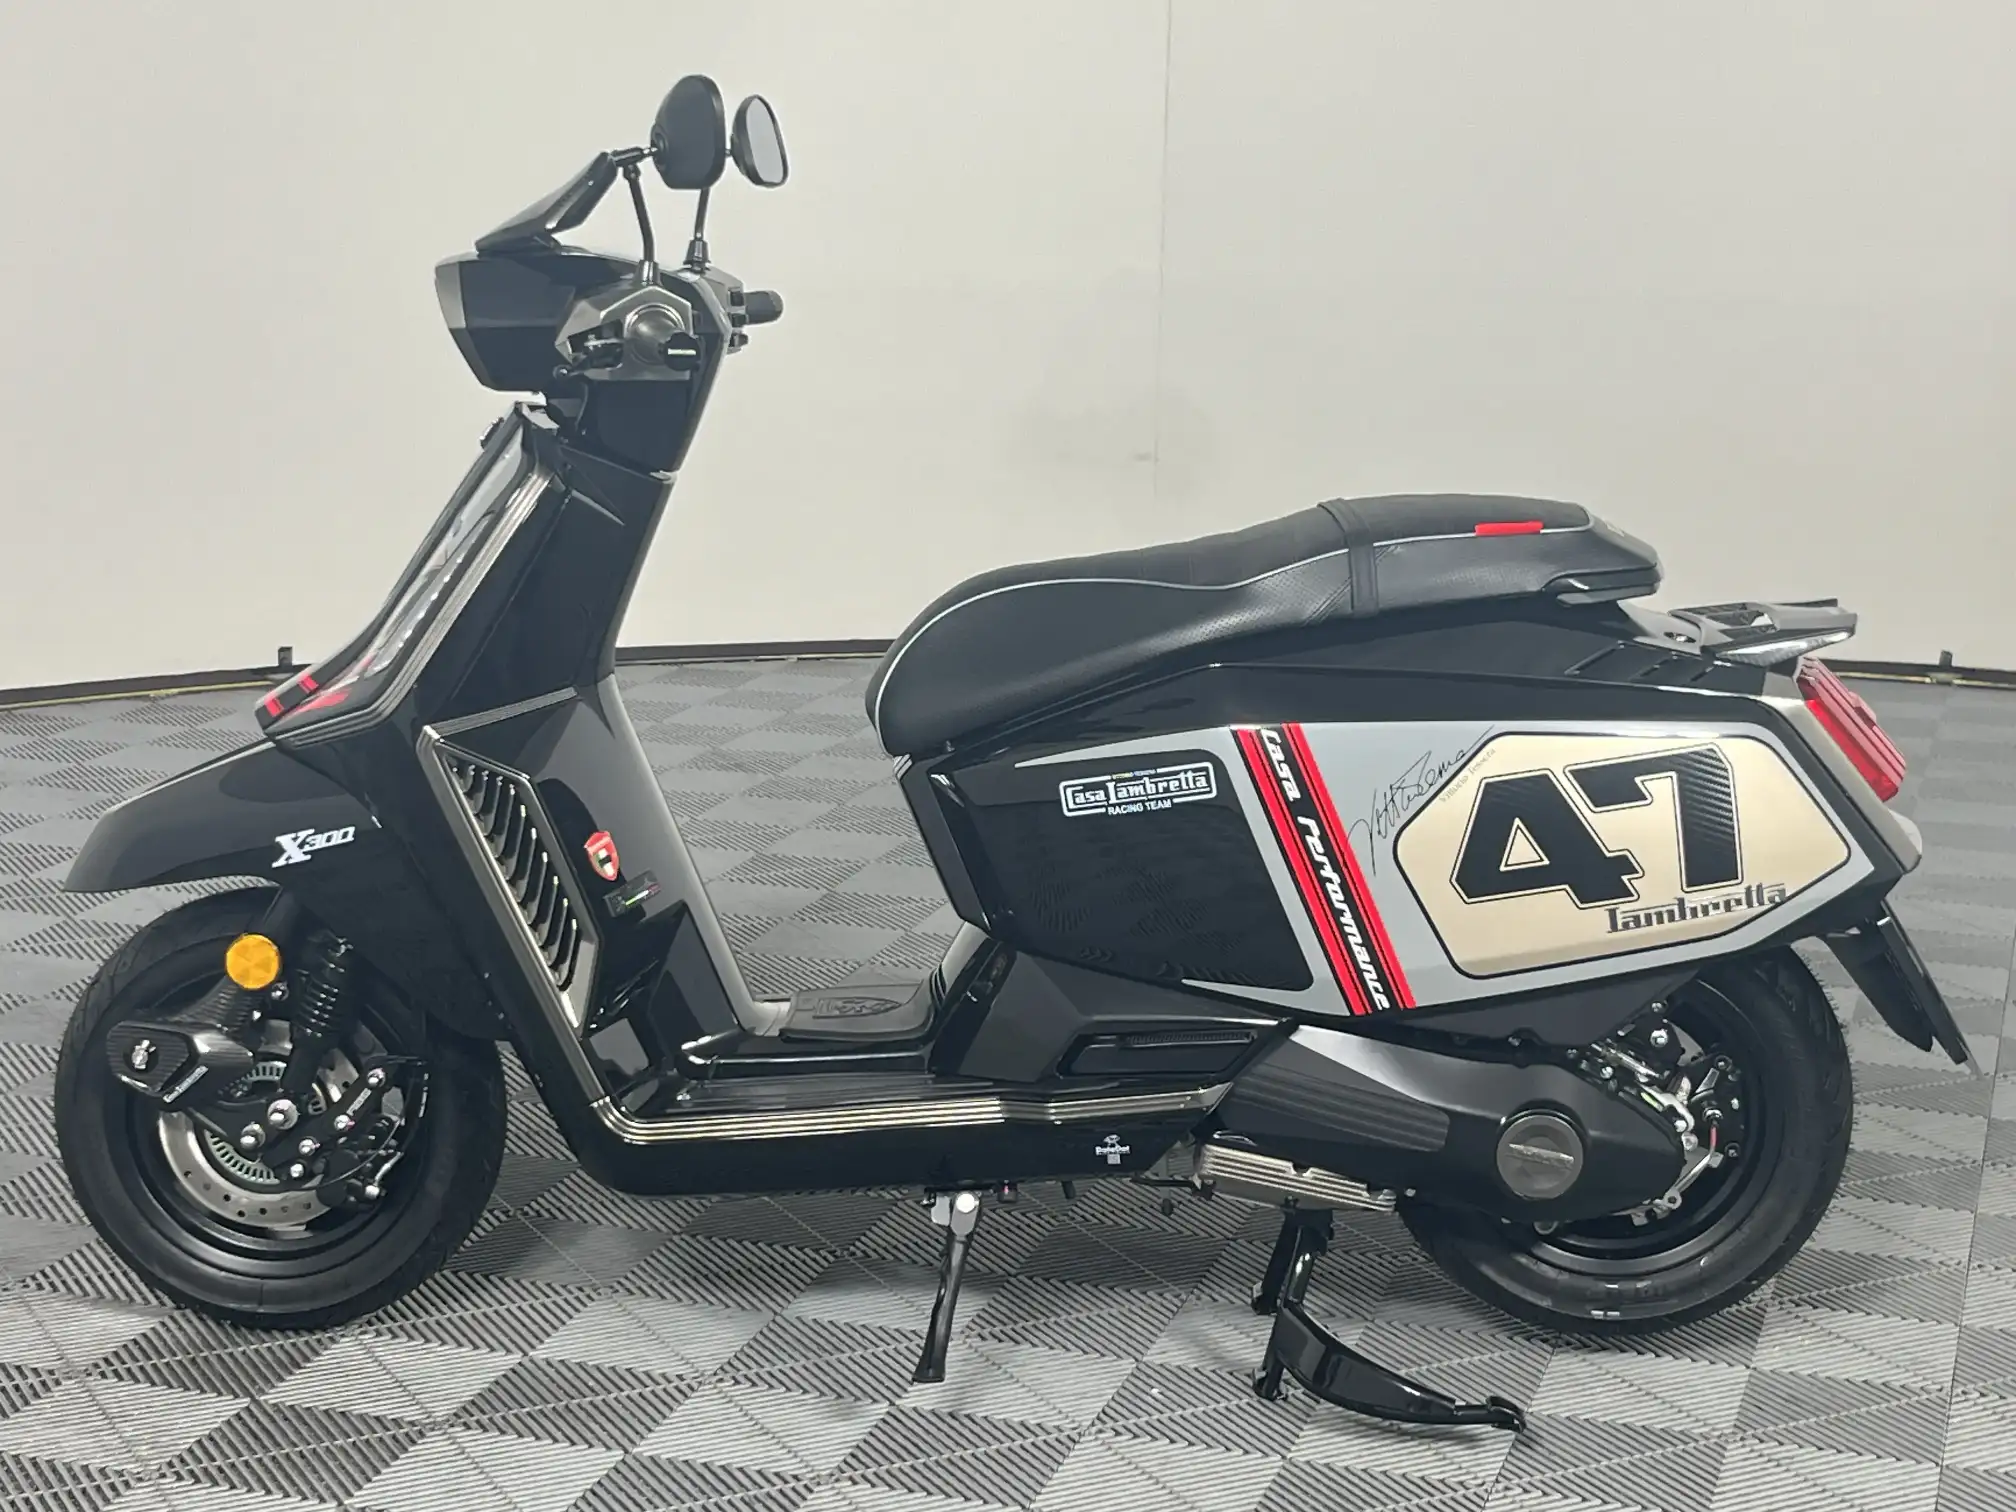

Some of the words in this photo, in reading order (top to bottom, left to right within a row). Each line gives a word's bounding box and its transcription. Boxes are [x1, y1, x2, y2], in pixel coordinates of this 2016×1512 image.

[1065, 785, 1107, 809] Casa
[1106, 769, 1211, 804] Lambretta
[1108, 803, 1143, 816] RACING
[1146, 799, 1172, 811] TEAM
[271, 826, 356, 869] X300
[1449, 743, 1743, 910] 47
[1260, 728, 1302, 802] Casa
[1297, 815, 1391, 1011] Performance
[1604, 882, 1787, 934] Lambretta
